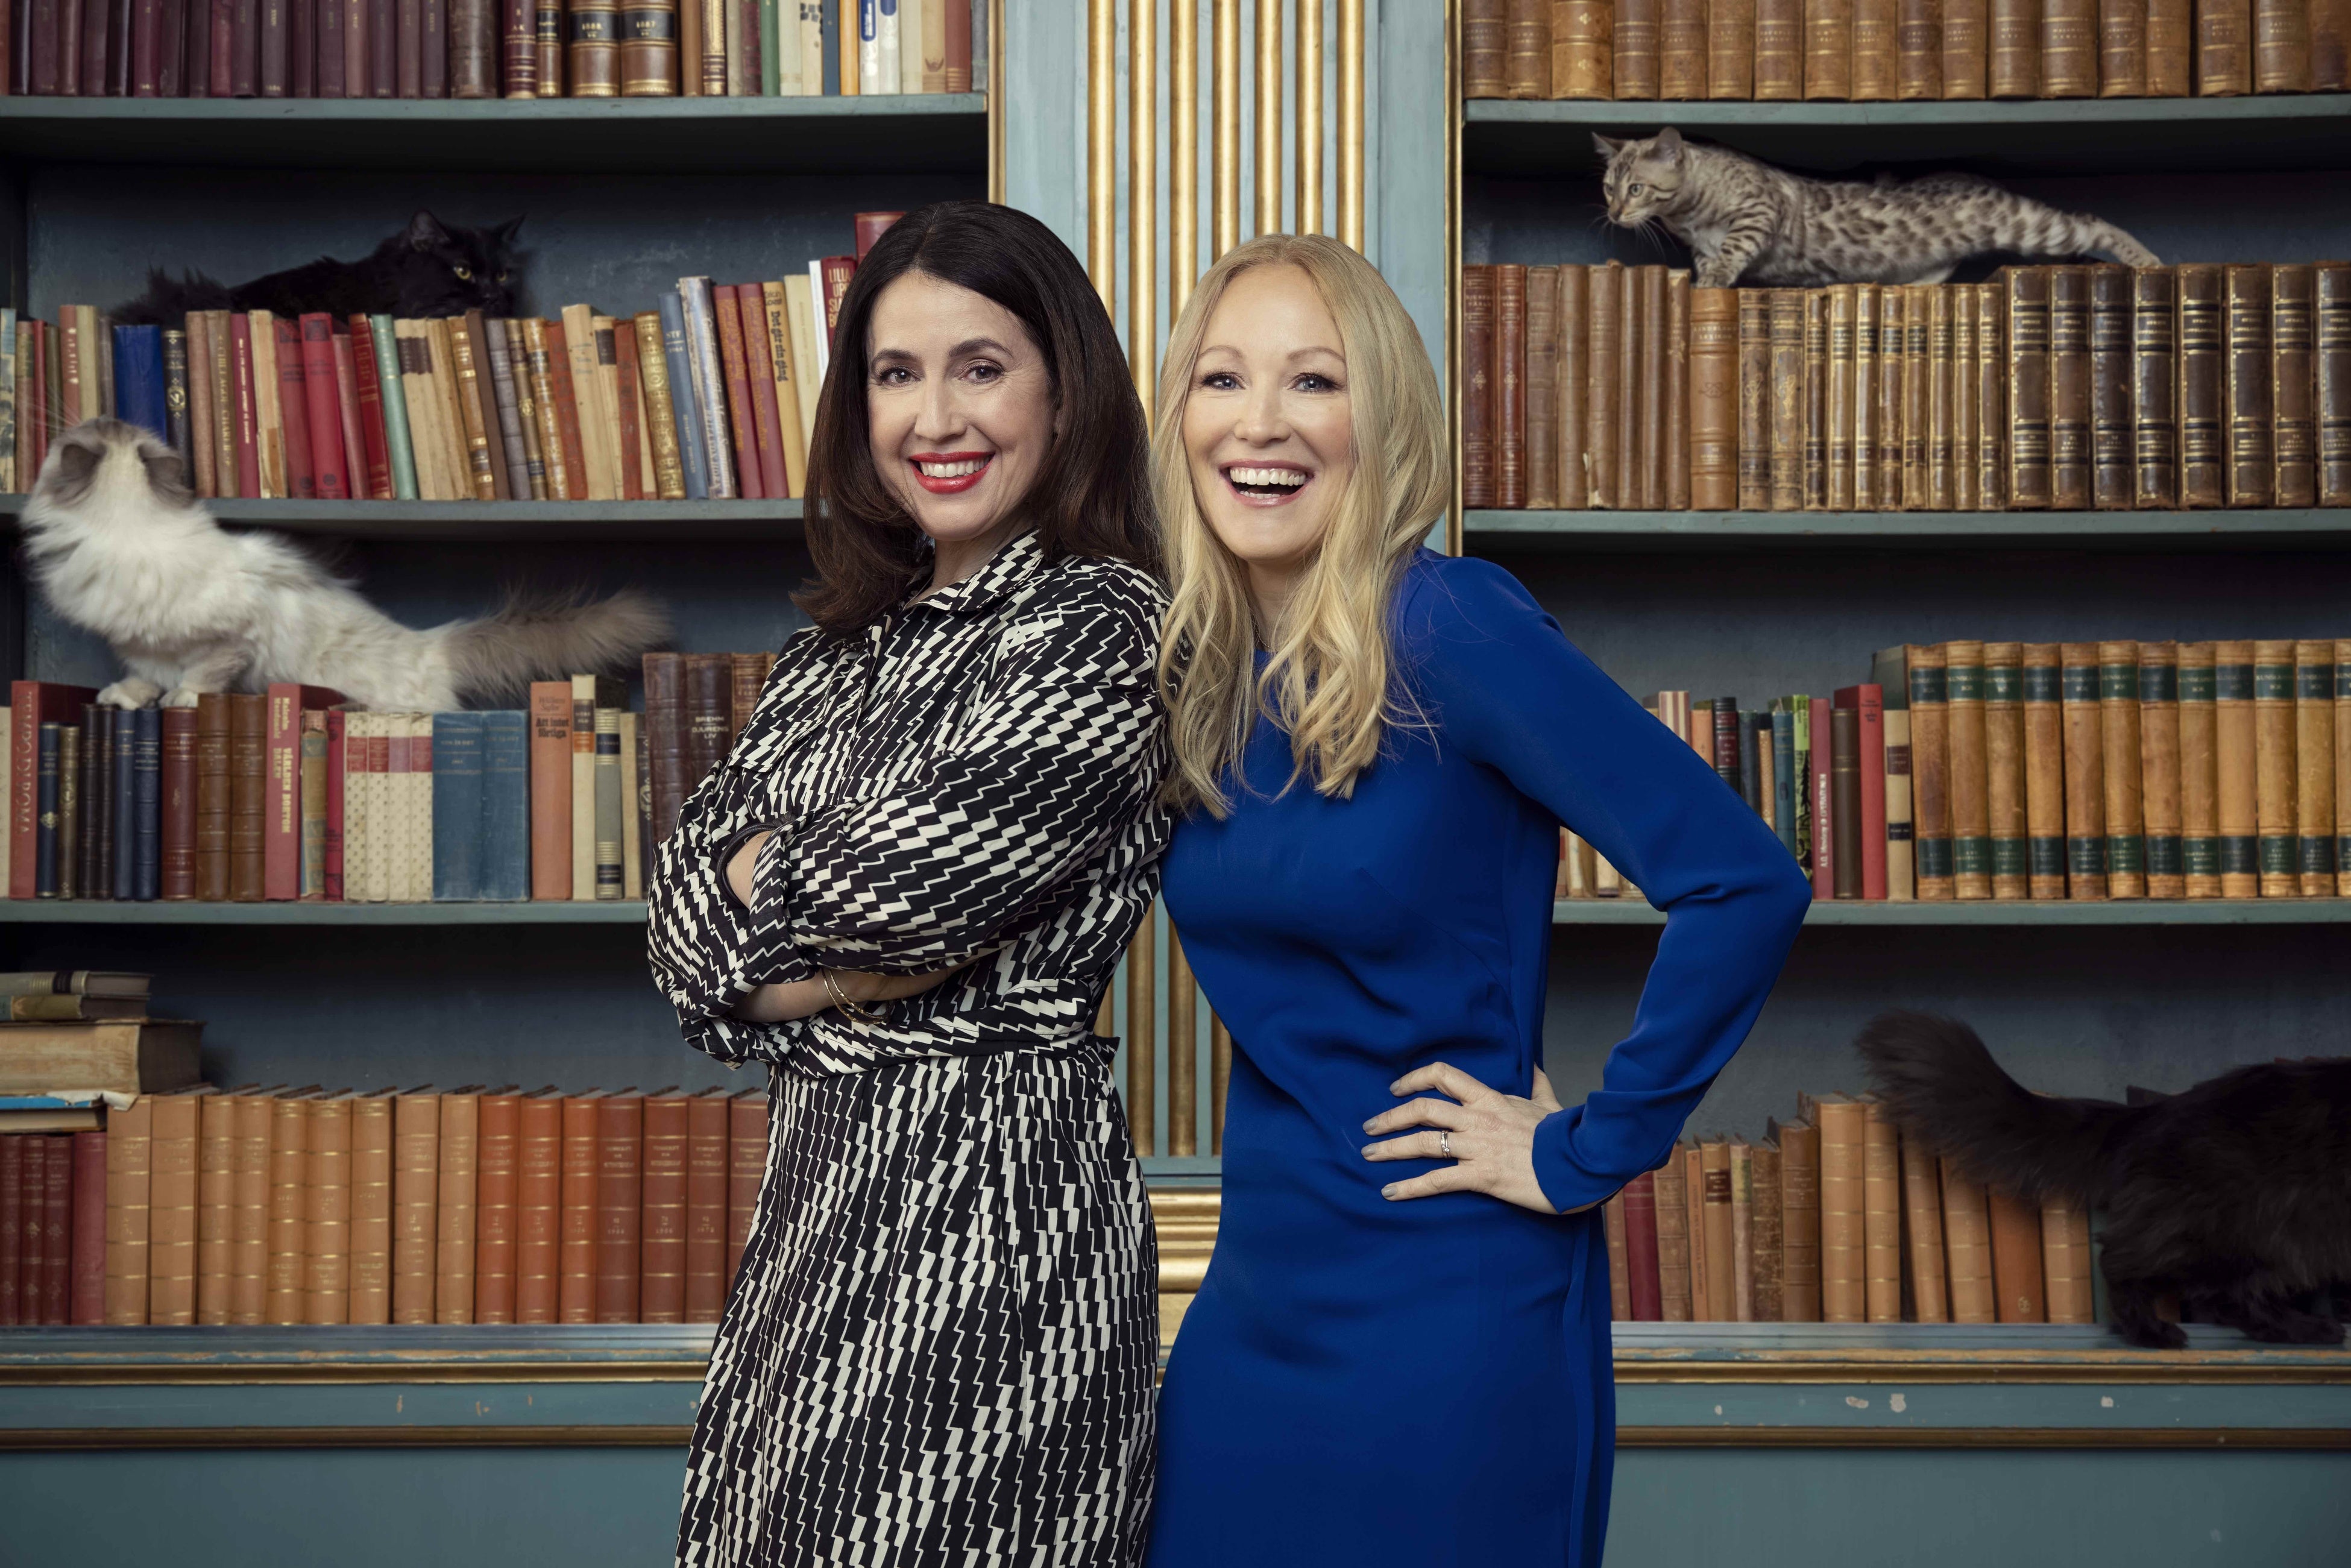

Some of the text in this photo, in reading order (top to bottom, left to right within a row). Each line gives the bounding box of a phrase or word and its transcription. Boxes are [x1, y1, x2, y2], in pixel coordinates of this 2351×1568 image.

[771, 311, 788, 382] Det går sin gång
[536, 717, 549, 727] Att
[15, 691, 32, 834] TEMPO DI ROMA
[282, 793, 292, 833] BORTOM
